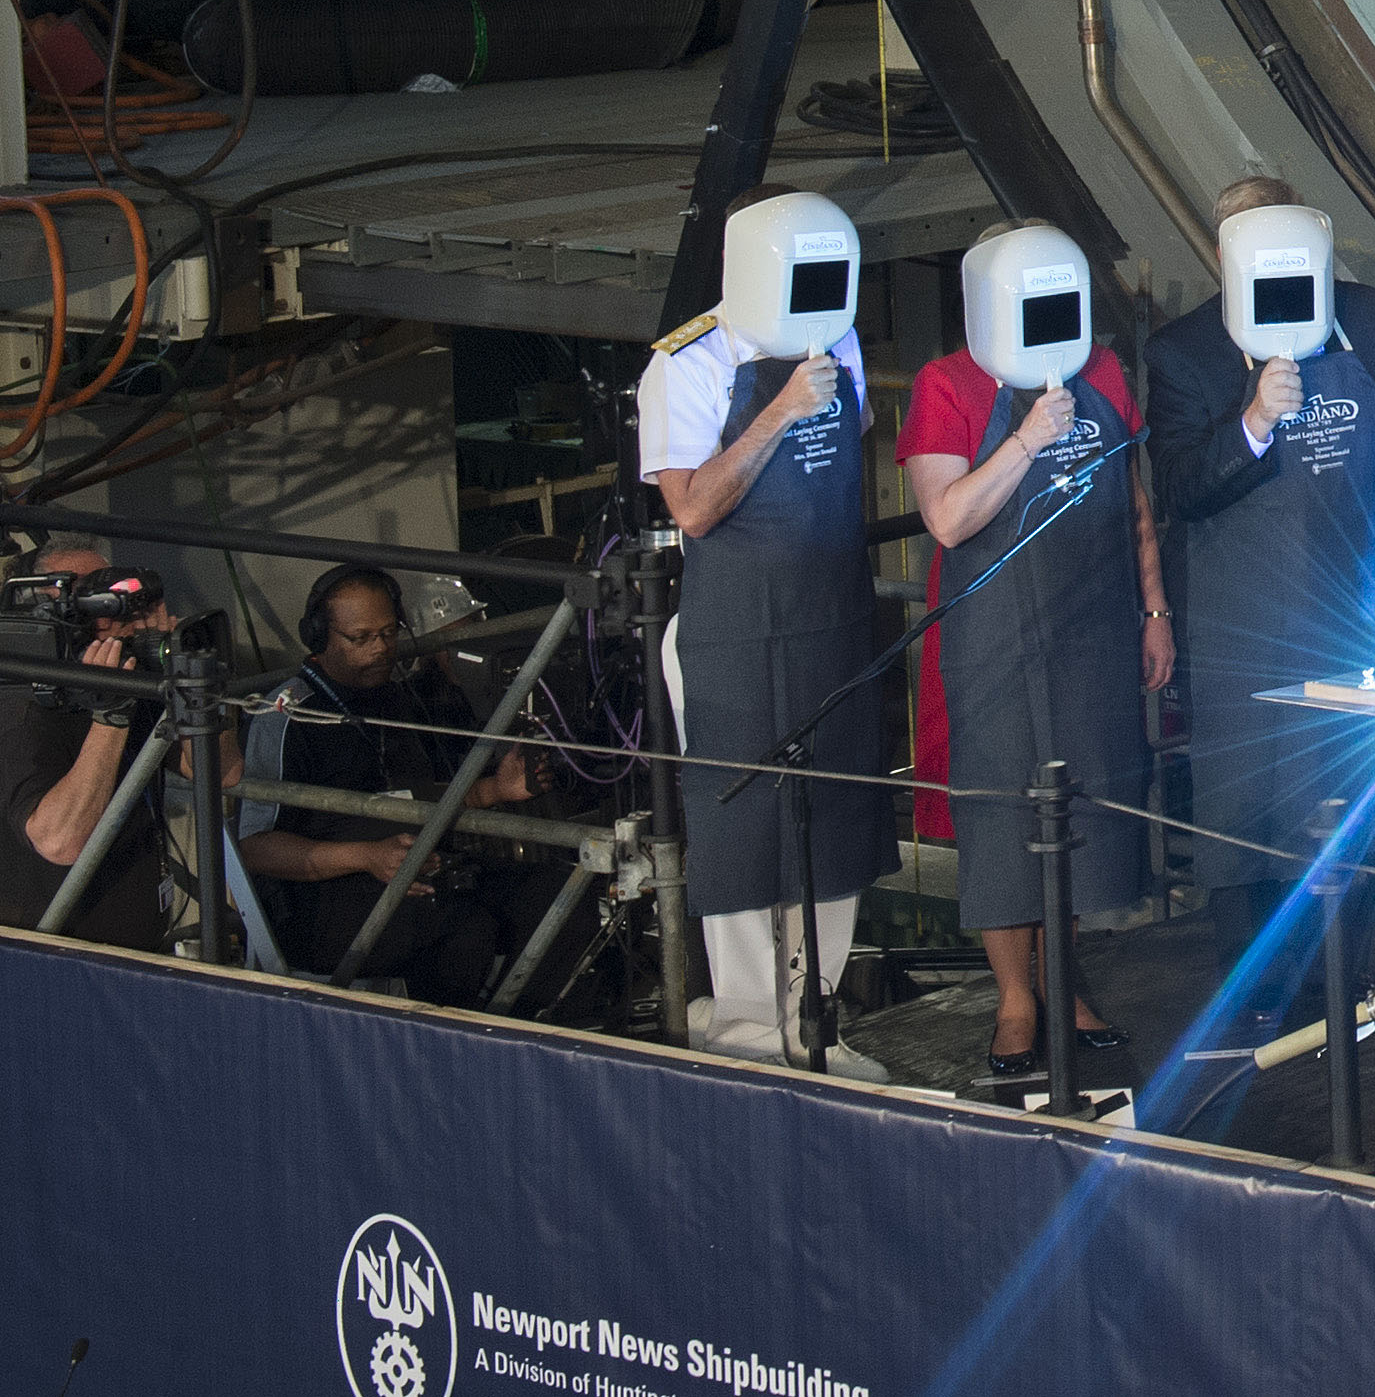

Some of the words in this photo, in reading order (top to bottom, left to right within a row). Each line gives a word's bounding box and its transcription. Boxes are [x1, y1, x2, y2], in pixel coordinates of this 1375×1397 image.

[1286, 433, 1301, 441] Keel
[1302, 430, 1324, 440] Laying
[1324, 424, 1356, 435] Ceremony
[1051, 446, 1074, 456] Laying
[473, 1291, 591, 1352] Newport
[598, 1319, 680, 1372] News
[474, 1347, 489, 1371] A
[494, 1351, 567, 1389] Division
[571, 1372, 590, 1395] of
